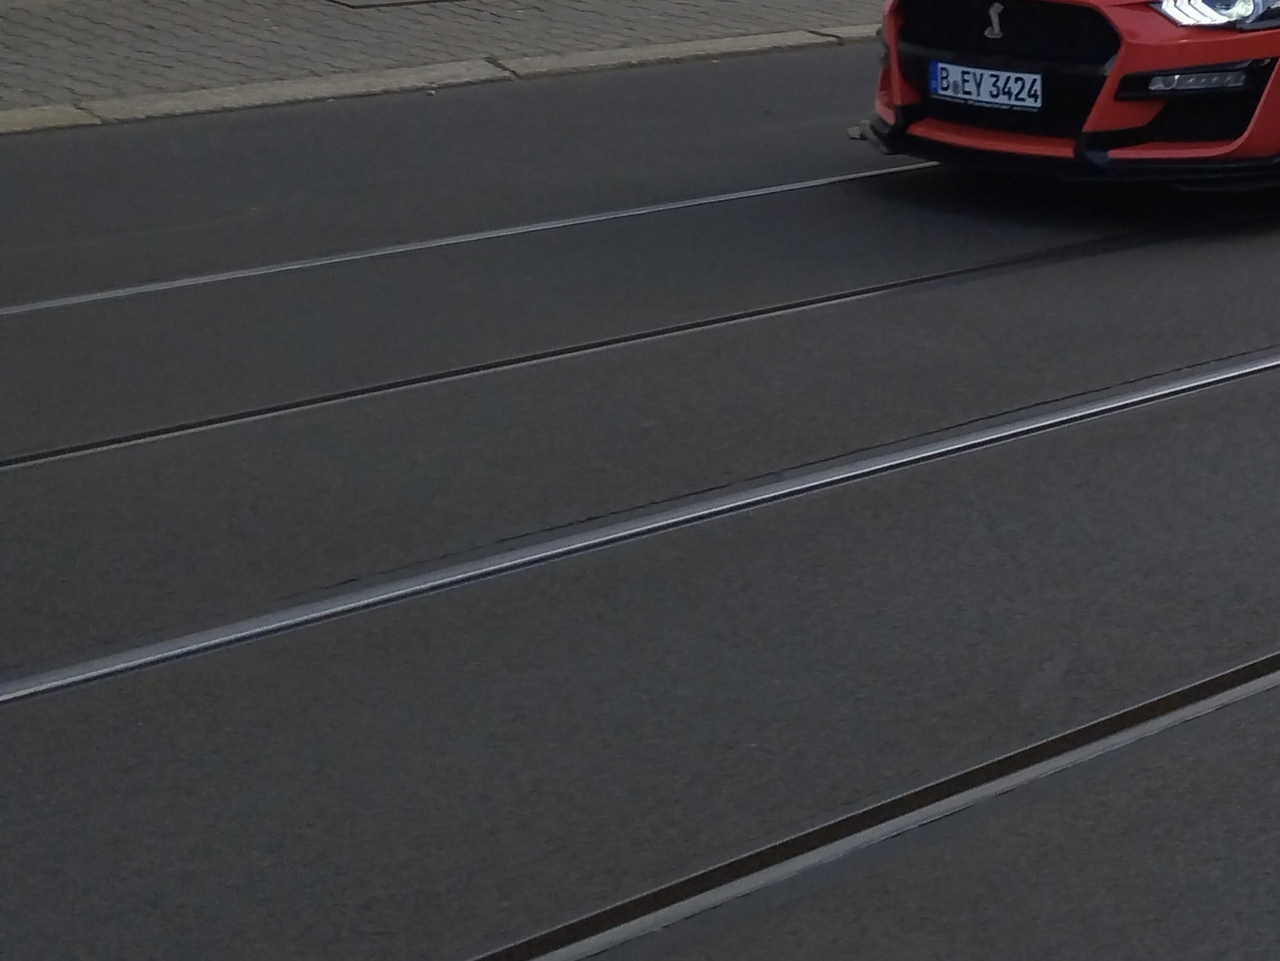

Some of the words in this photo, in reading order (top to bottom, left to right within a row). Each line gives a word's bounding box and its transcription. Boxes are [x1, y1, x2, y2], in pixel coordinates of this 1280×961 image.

[940, 66, 951, 92] B
[961, 70, 984, 97] EY
[989, 73, 1040, 103] 3424
